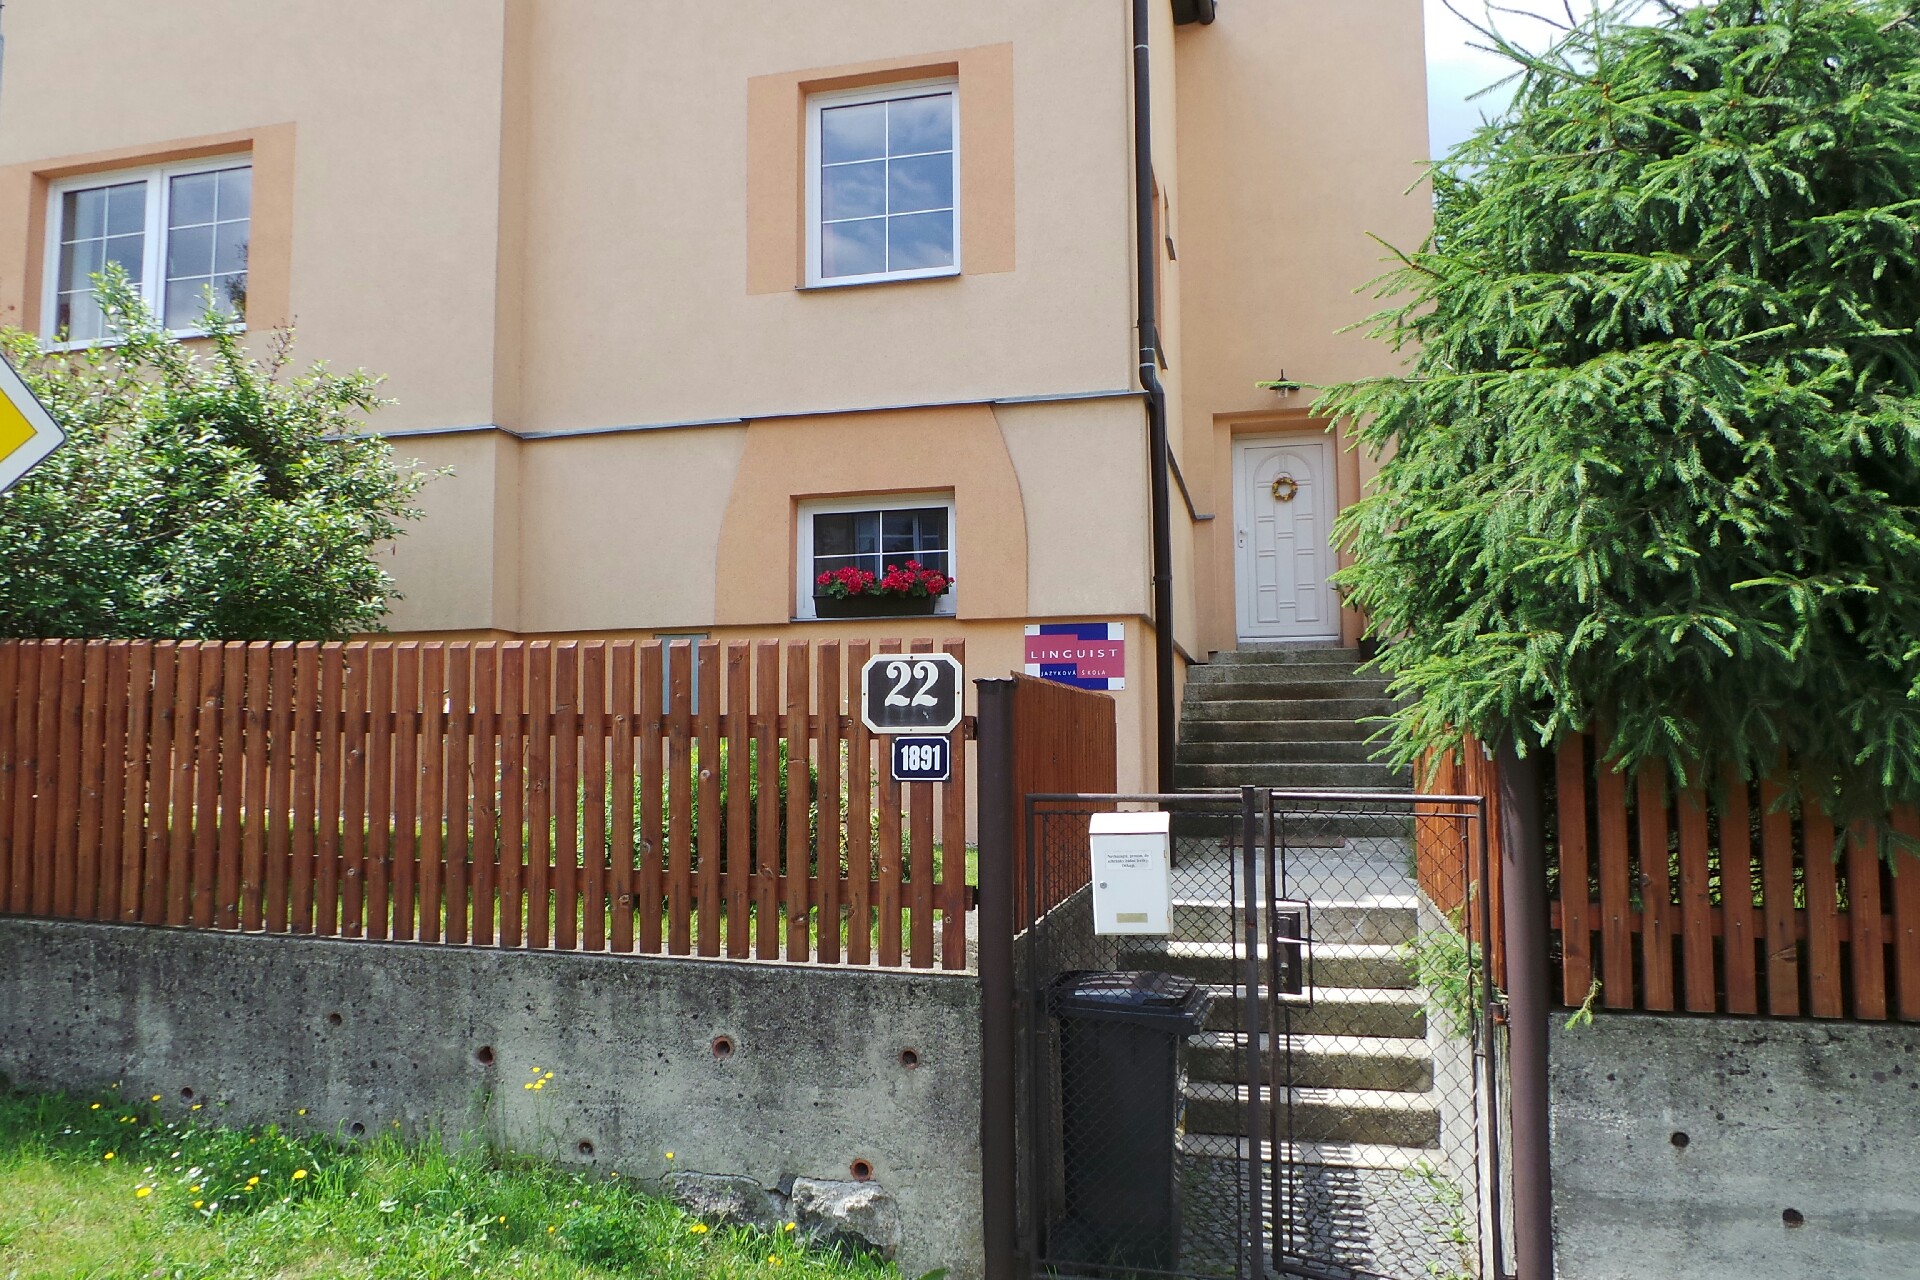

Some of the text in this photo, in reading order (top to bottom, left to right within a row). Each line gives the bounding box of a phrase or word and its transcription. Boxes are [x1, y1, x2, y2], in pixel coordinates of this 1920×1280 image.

[1031, 649, 1118, 659] LINGUIST
[1041, 669, 1077, 677] JAZYKOVÁ
[884, 661, 939, 707] 22
[901, 745, 940, 771] 1891
